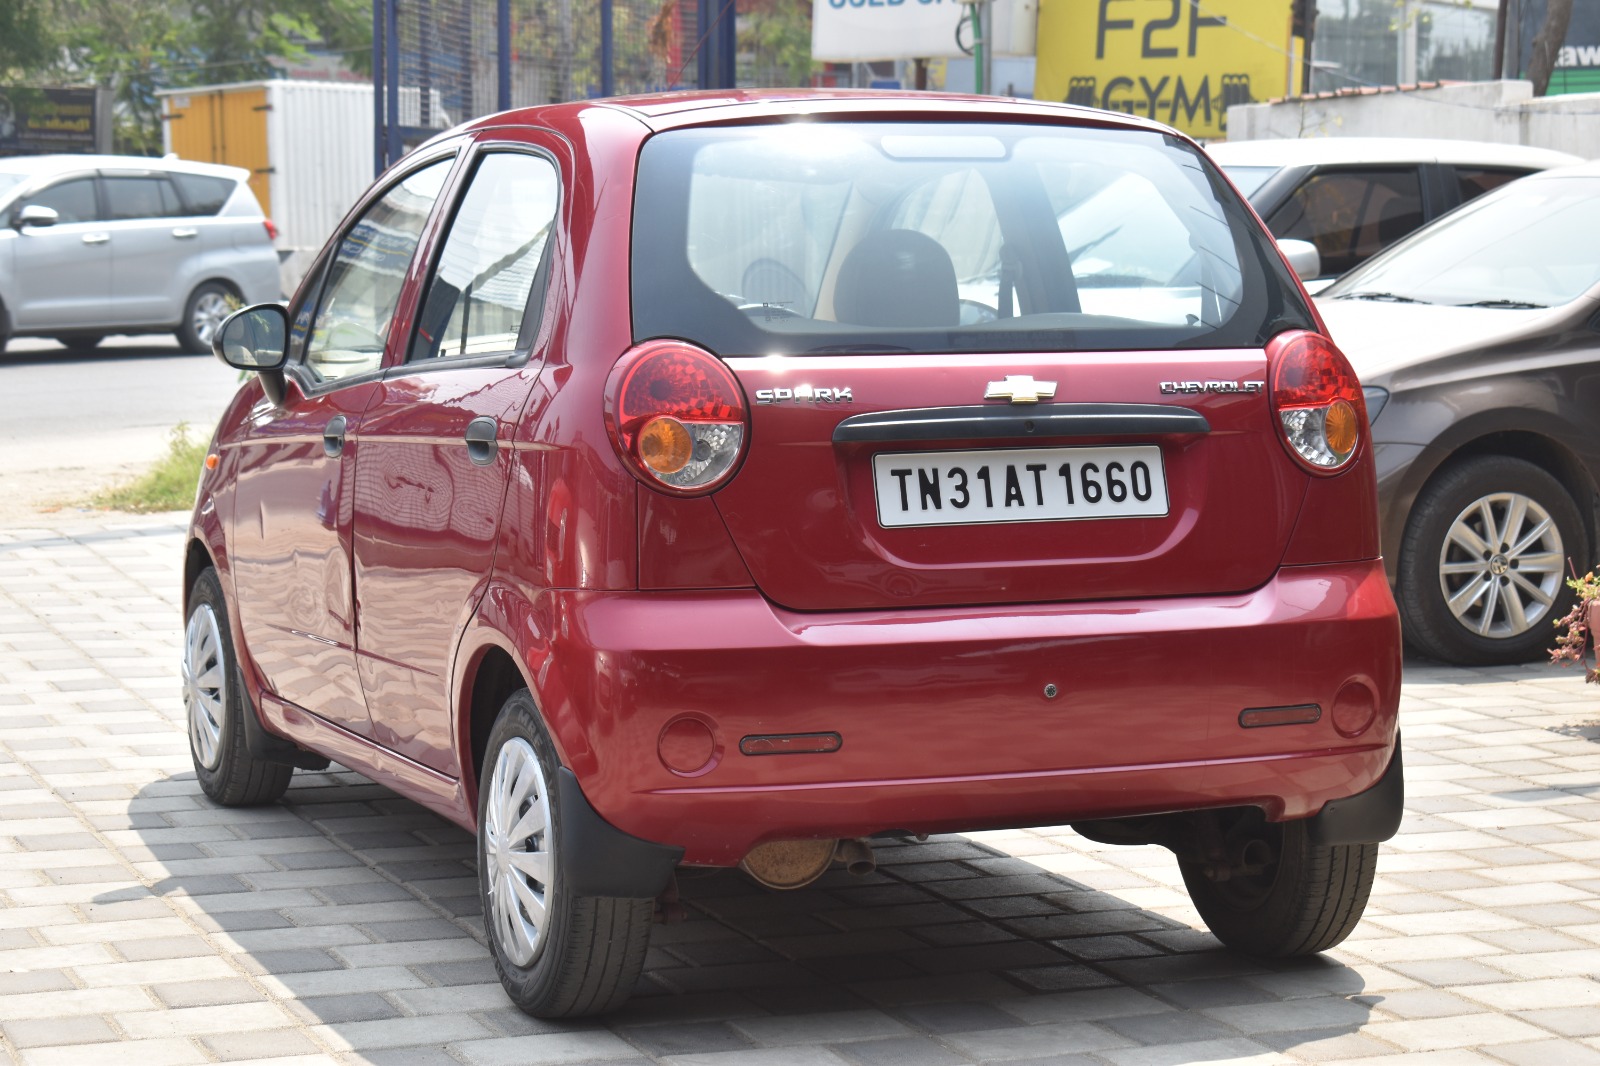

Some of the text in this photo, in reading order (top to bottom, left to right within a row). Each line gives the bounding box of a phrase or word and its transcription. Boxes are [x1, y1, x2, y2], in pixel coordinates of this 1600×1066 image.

[1096, 0, 1227, 60] F2F
[755, 384, 853, 405] SPARK
[1159, 381, 1264, 394] CHEVROLET
